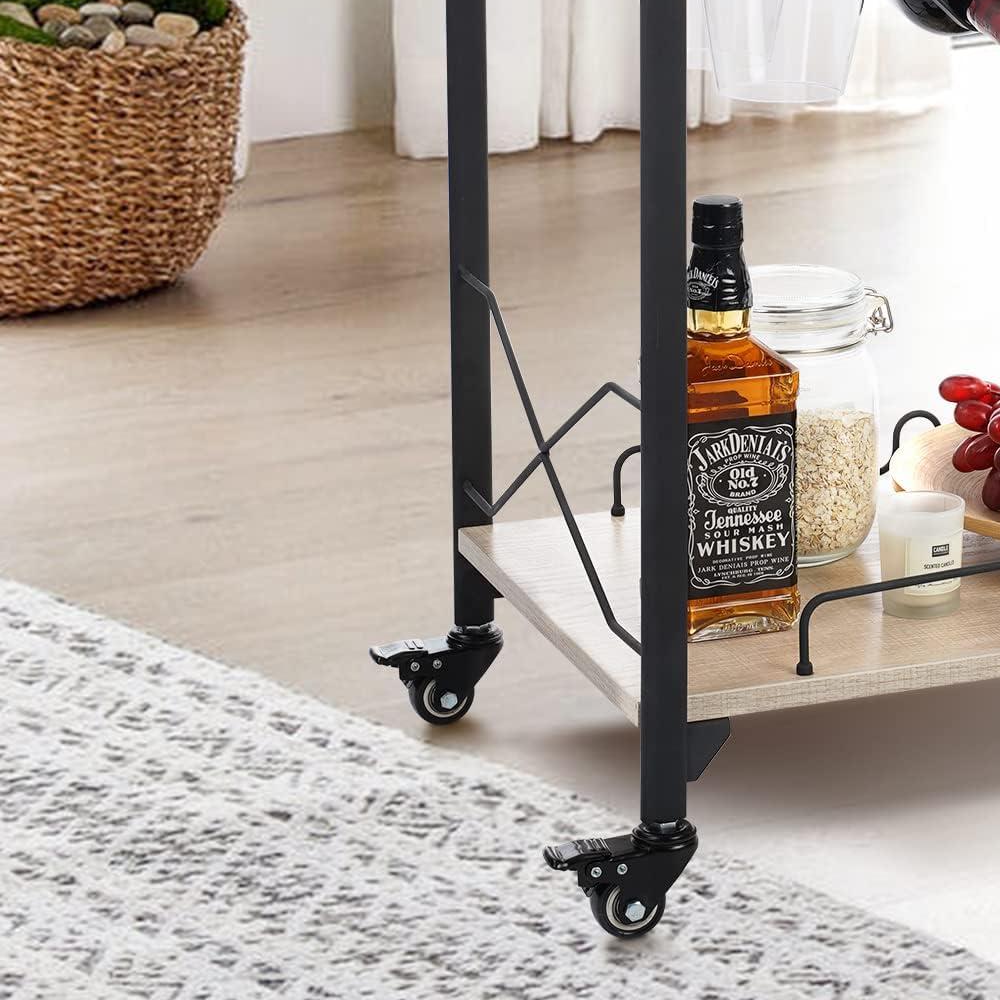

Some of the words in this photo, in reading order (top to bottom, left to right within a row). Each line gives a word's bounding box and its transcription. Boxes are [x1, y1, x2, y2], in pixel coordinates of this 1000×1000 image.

[729, 466, 755, 480] Old
[729, 489, 757, 498] BRAND
[727, 505, 758, 515] QUALITY
[704, 509, 782, 531] Tennessee
[704, 529, 740, 540] SOUR
[748, 523, 784, 534] MASH
[697, 531, 790, 558] WHISKEY
[697, 565, 717, 574] JARK
[718, 560, 748, 571] DENIAIS
[750, 558, 769, 567] PROP
[770, 555, 790, 564] WINE
